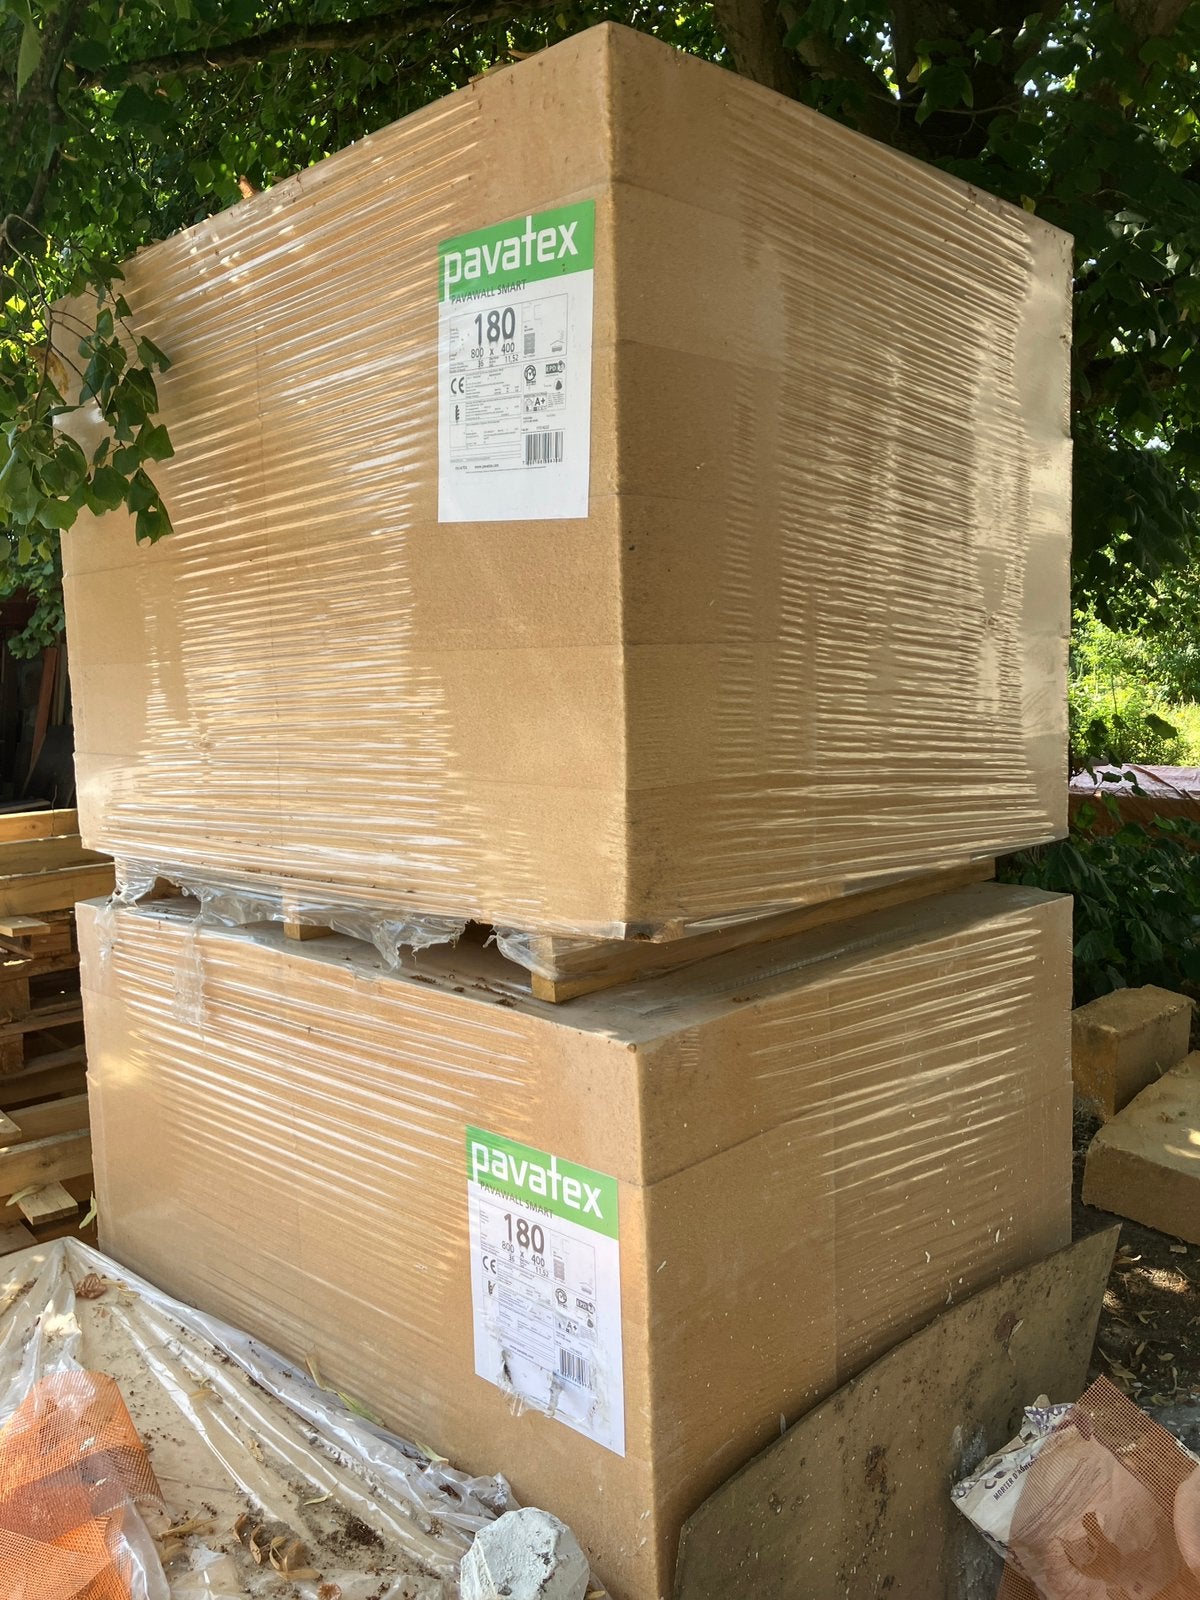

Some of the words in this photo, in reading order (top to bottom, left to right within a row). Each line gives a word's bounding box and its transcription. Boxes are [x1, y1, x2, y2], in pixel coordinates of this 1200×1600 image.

[444, 215, 578, 302] pavatex
[451, 288, 495, 305] PAVAWALL
[497, 279, 527, 296] SMART
[474, 307, 516, 346] 180
[471, 347, 484, 359] 800
[501, 342, 515, 356] 400
[472, 1141, 603, 1219] pavatex
[480, 1181, 525, 1205] PAVAWALL
[525, 1199, 554, 1219] SMART
[504, 1213, 545, 1254] 180
[501, 1240, 514, 1253] 800
[531, 1255, 545, 1267] 400
